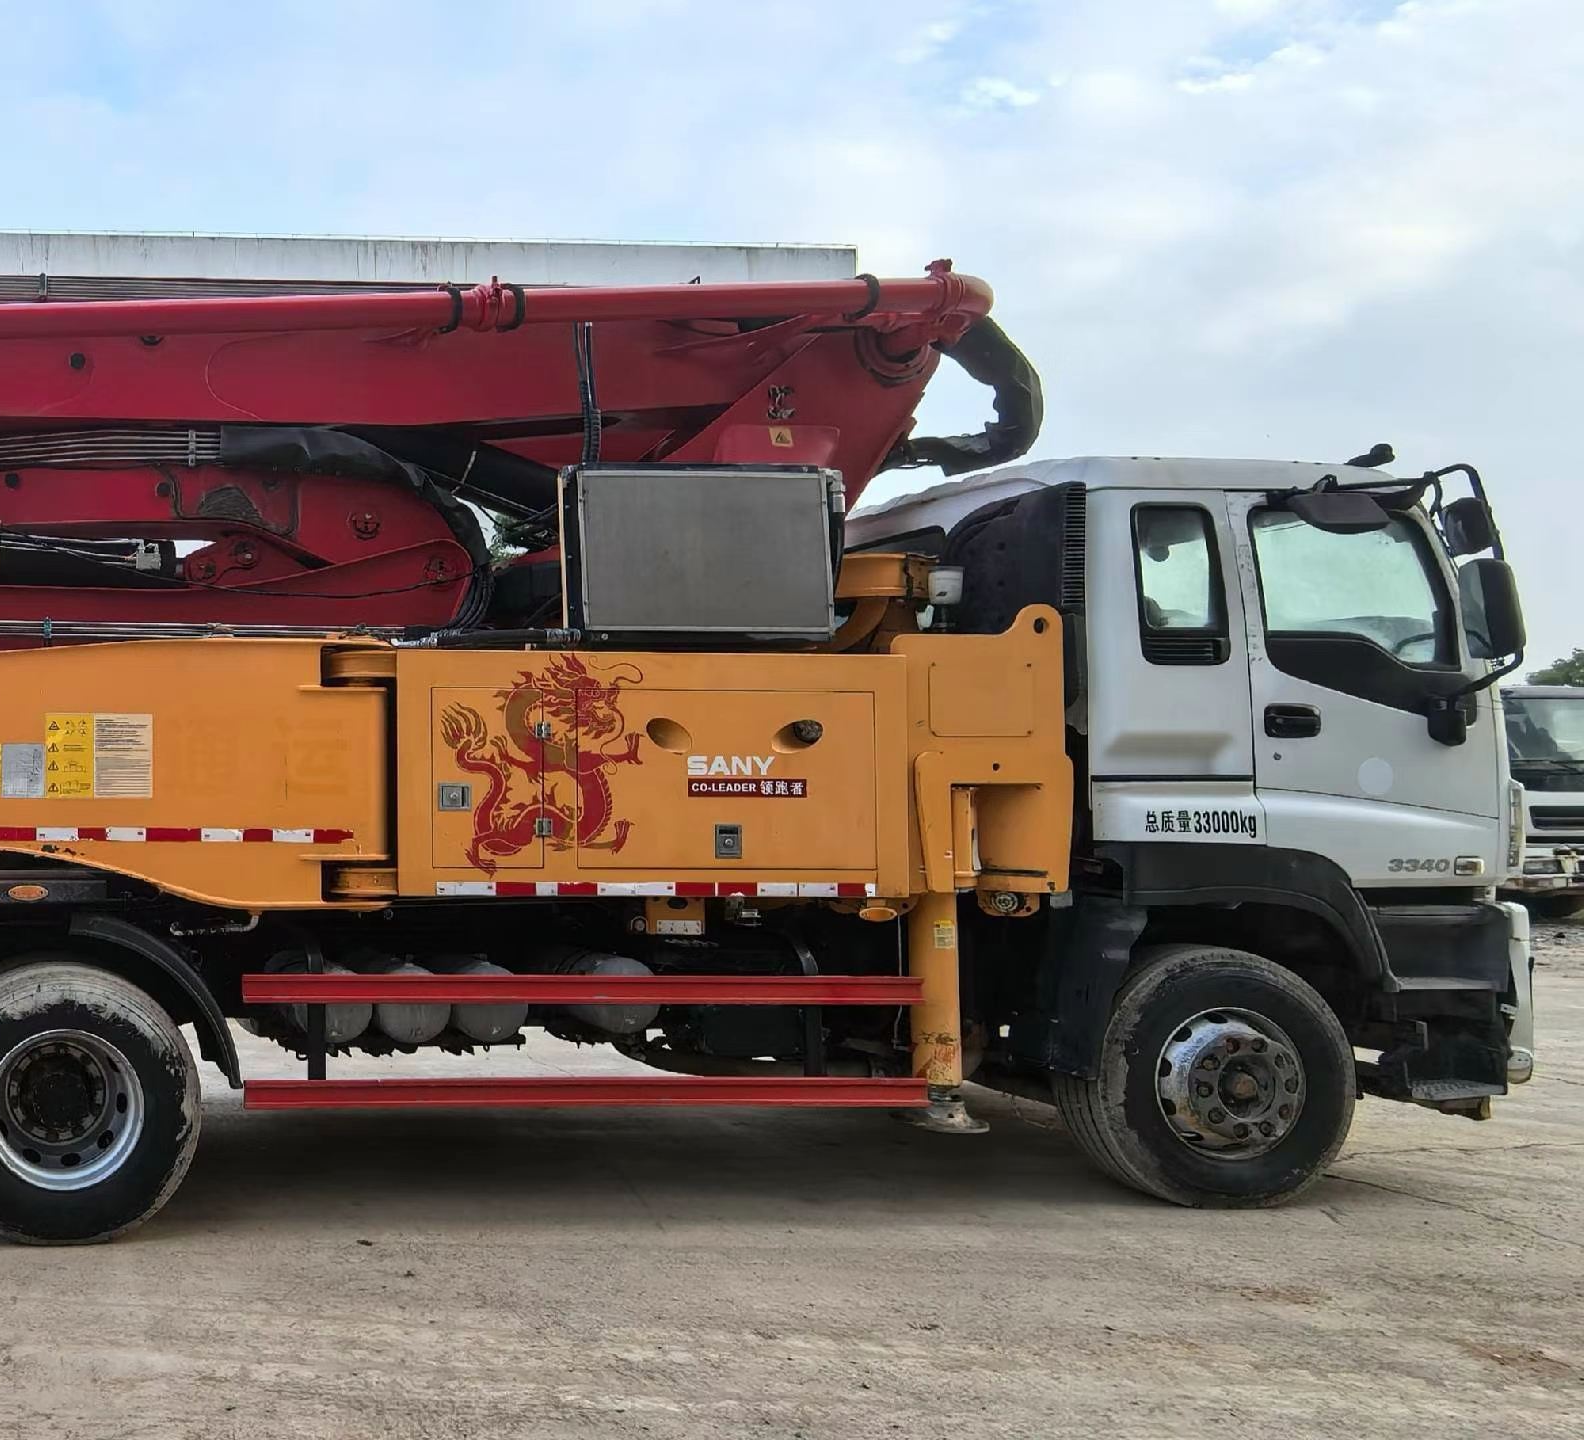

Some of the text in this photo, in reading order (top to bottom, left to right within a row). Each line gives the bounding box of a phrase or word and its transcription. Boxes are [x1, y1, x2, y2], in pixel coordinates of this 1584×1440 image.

[688, 756, 772, 775] SANY
[691, 781, 804, 796] CO-LEADER 领跑者
[1145, 811, 1257, 838] 总质量33000kg
[1388, 858, 1450, 873] 3340
